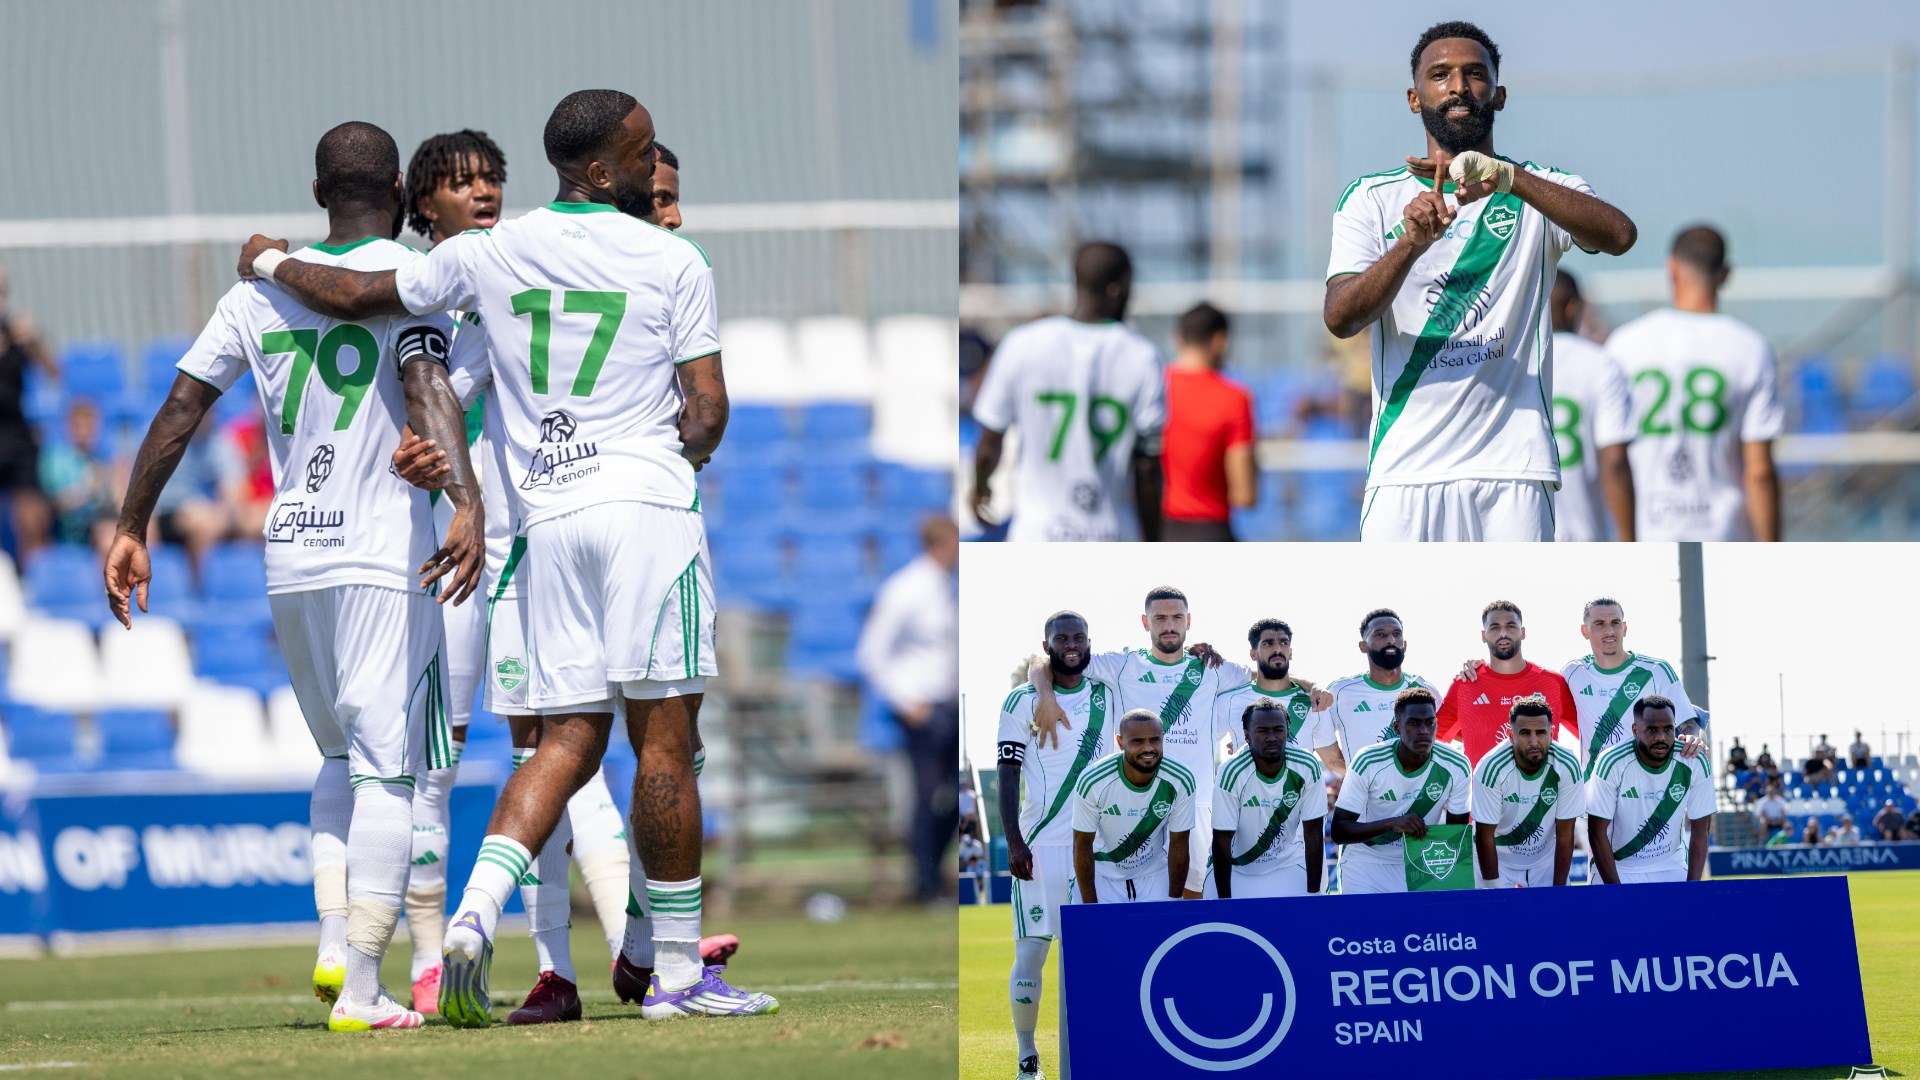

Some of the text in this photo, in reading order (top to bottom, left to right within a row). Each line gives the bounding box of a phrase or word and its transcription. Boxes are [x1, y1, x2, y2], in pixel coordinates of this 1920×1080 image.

[510, 288, 628, 397] 17
[1440, 356, 1464, 368] Sea
[1467, 344, 1504, 365] Global
[261, 324, 380, 436] 79
[1633, 367, 1728, 434] 28
[1034, 391, 1129, 463] 79
[1001, 744, 1014, 759] C
[53, 825, 140, 891] OF
[1328, 932, 1477, 956] Costa Cálida
[1330, 952, 1799, 1007] REGION OF MURCIA
[1335, 1019, 1423, 1046] SPAIN
